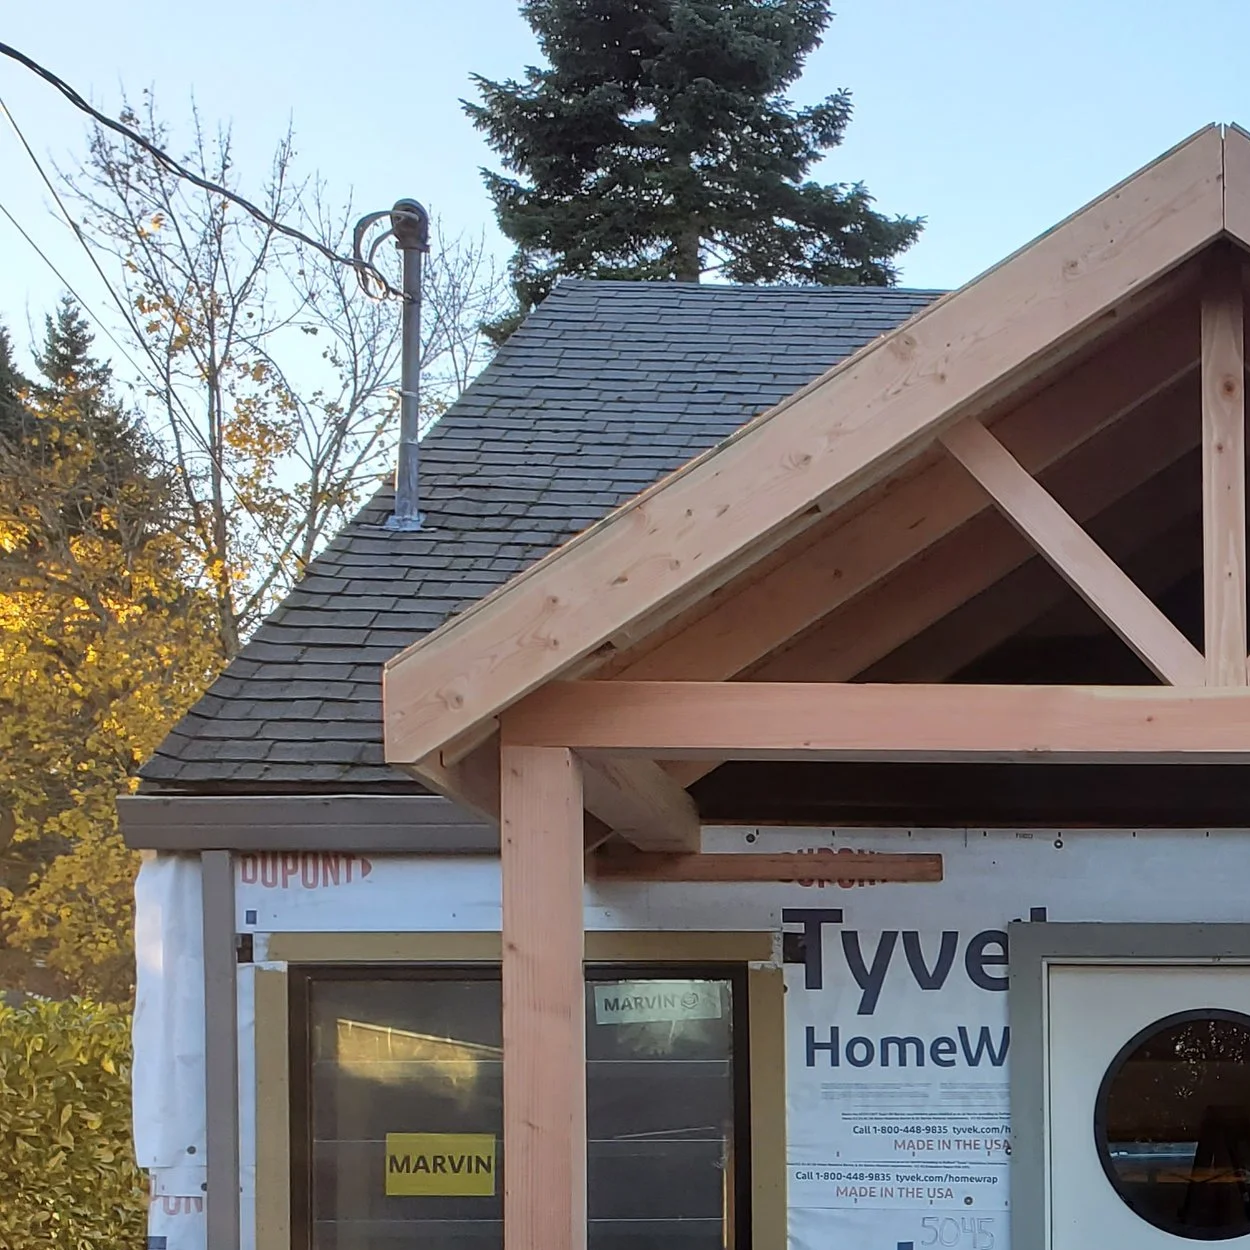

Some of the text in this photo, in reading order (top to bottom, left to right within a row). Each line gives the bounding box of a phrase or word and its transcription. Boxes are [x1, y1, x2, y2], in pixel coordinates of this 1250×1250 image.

[782, 907, 1047, 1015] Tyve
[604, 994, 676, 1012] MARVIN
[853, 1125, 870, 1134] Call
[873, 1125, 948, 1134] 1-800-448-9835
[894, 1139, 1011, 1150] MADE IN THE USA
[389, 1154, 492, 1175] MARVIN
[795, 1171, 998, 1184] Call 1-800-448-9835 tyvek.com/homewrap
[836, 1186, 953, 1199] MADE IN THE USA
[921, 1216, 994, 1250] 5045
